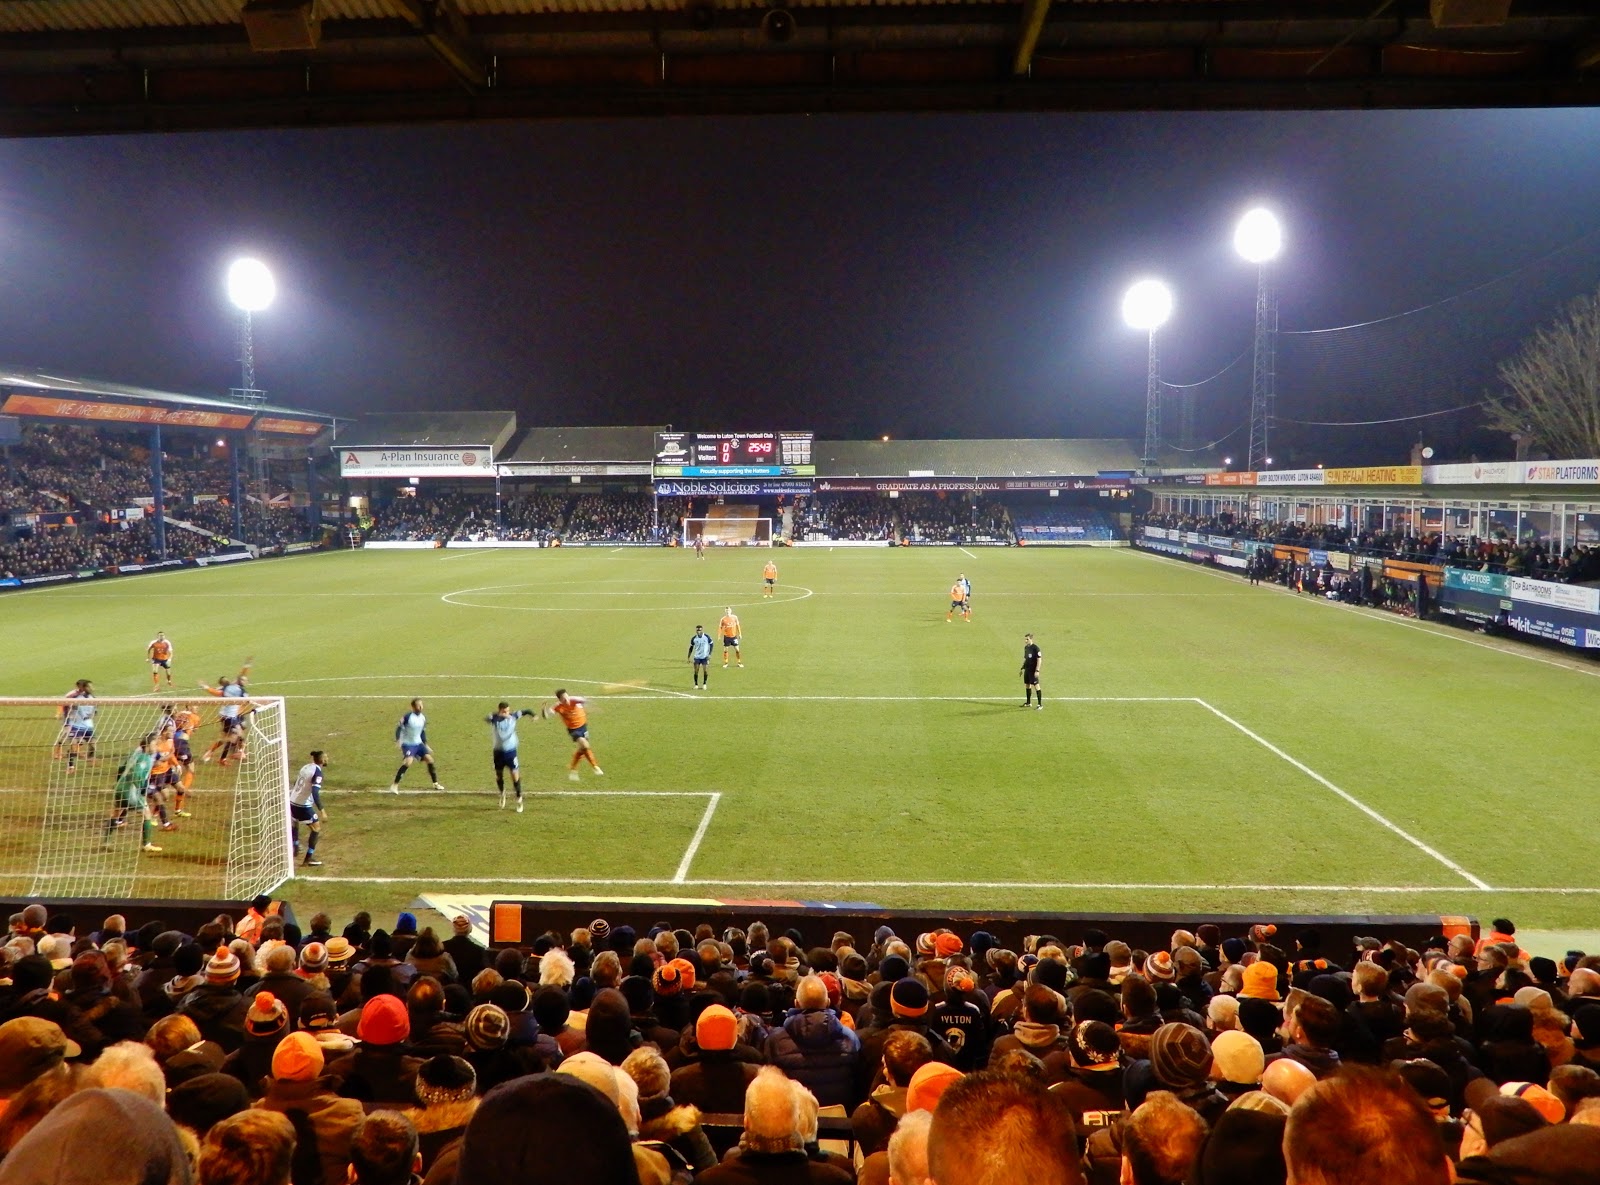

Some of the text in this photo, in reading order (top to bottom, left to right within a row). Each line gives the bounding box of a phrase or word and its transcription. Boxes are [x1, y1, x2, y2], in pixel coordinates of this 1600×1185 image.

[56, 402, 146, 419] WE ARE THE TOWN
[150, 410, 164, 421] WE
[722, 443, 730, 452] 0
[381, 452, 460, 461] A-Plan Insurance
[722, 453, 730, 463] 0
[554, 465, 596, 473] STORAGE
[1268, 474, 1280, 482] BOLTON
[1280, 474, 1296, 482] WINDOWS
[1298, 473, 1309, 481] LUTON
[1327, 471, 1340, 482] SUN
[1366, 469, 1396, 482] HEATING
[672, 482, 760, 492] Noble Solicitors
[1466, 573, 1491, 585] penrose
